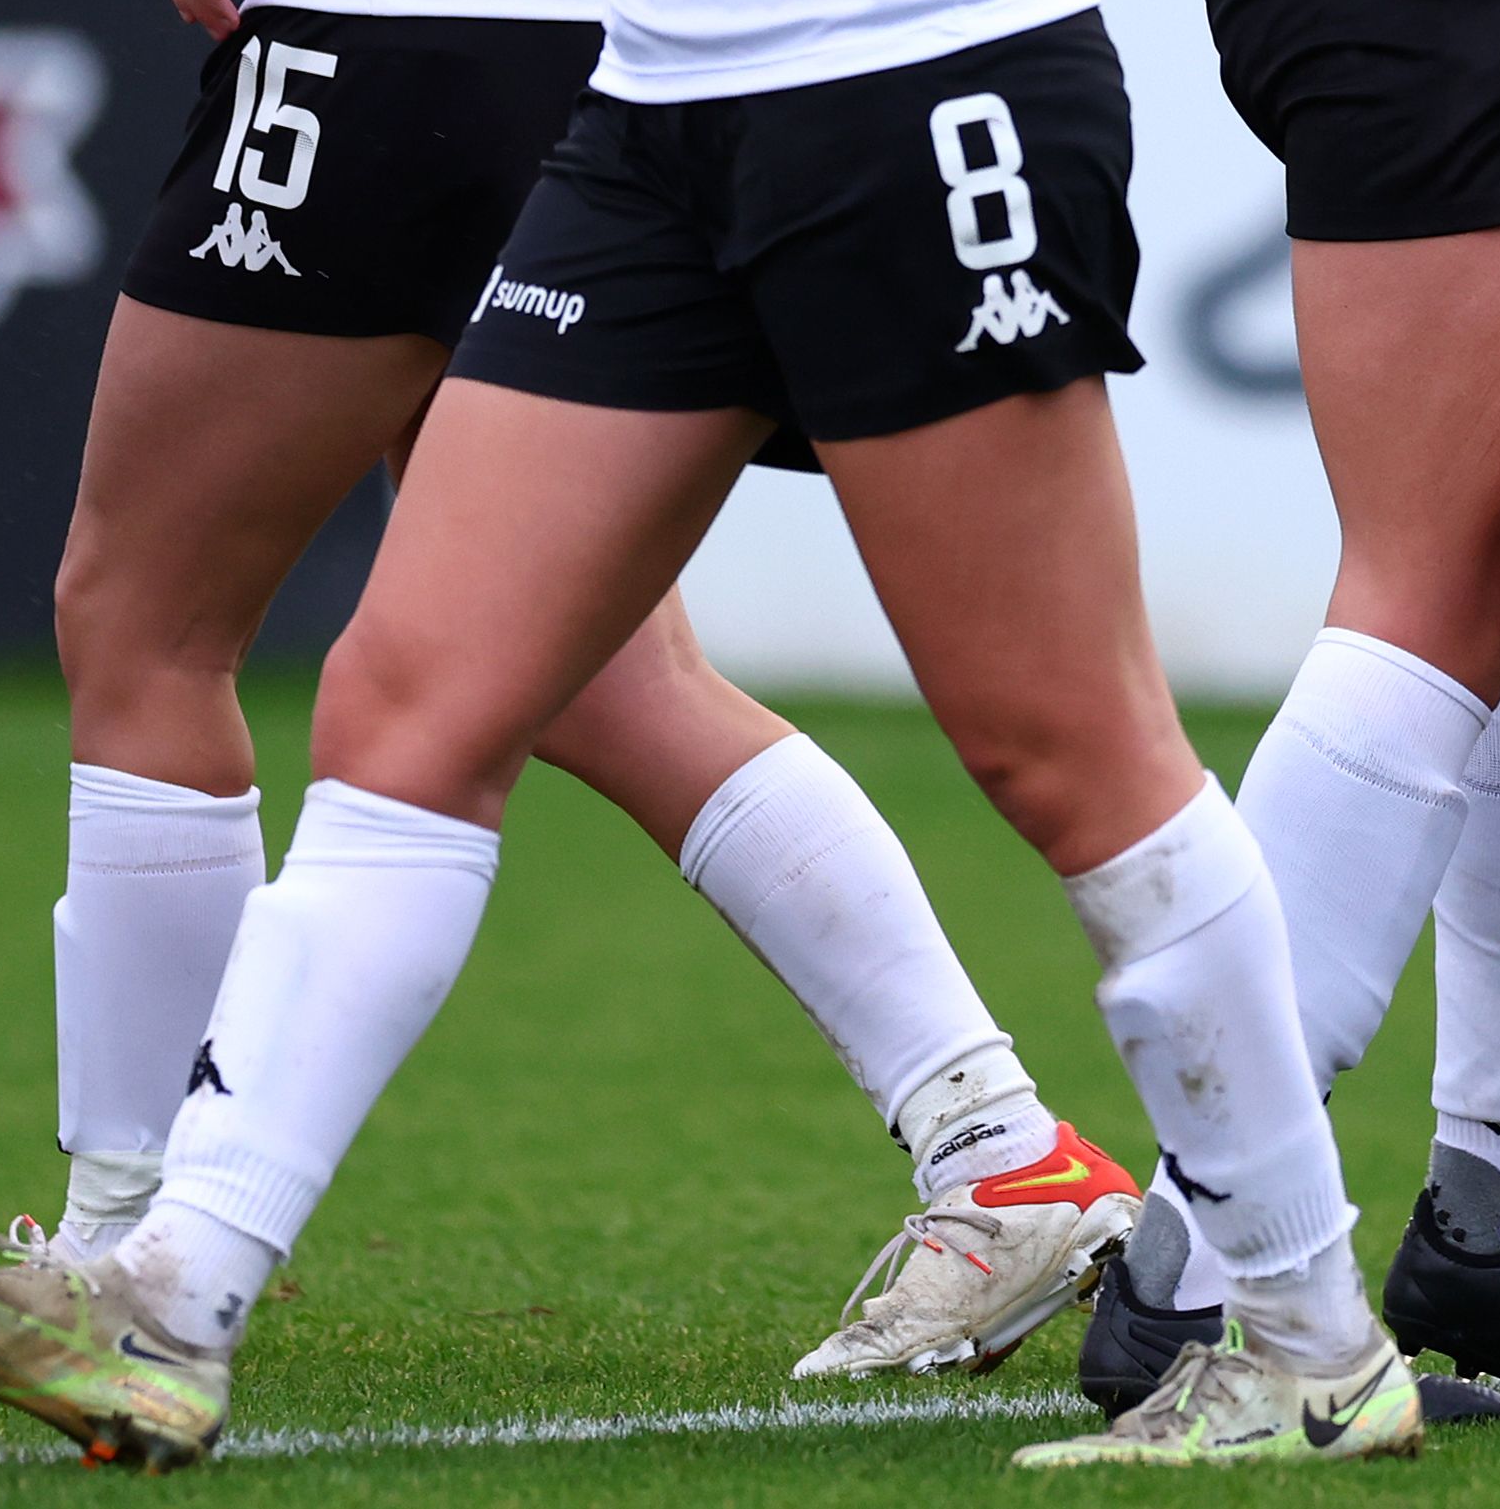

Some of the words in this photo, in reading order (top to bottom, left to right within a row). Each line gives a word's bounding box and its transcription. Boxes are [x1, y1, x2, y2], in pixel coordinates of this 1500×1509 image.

[213, 35, 338, 210] 15
[929, 92, 1038, 270] 8
[492, 280, 586, 335] sumup
[930, 1124, 1006, 1165] adidas
